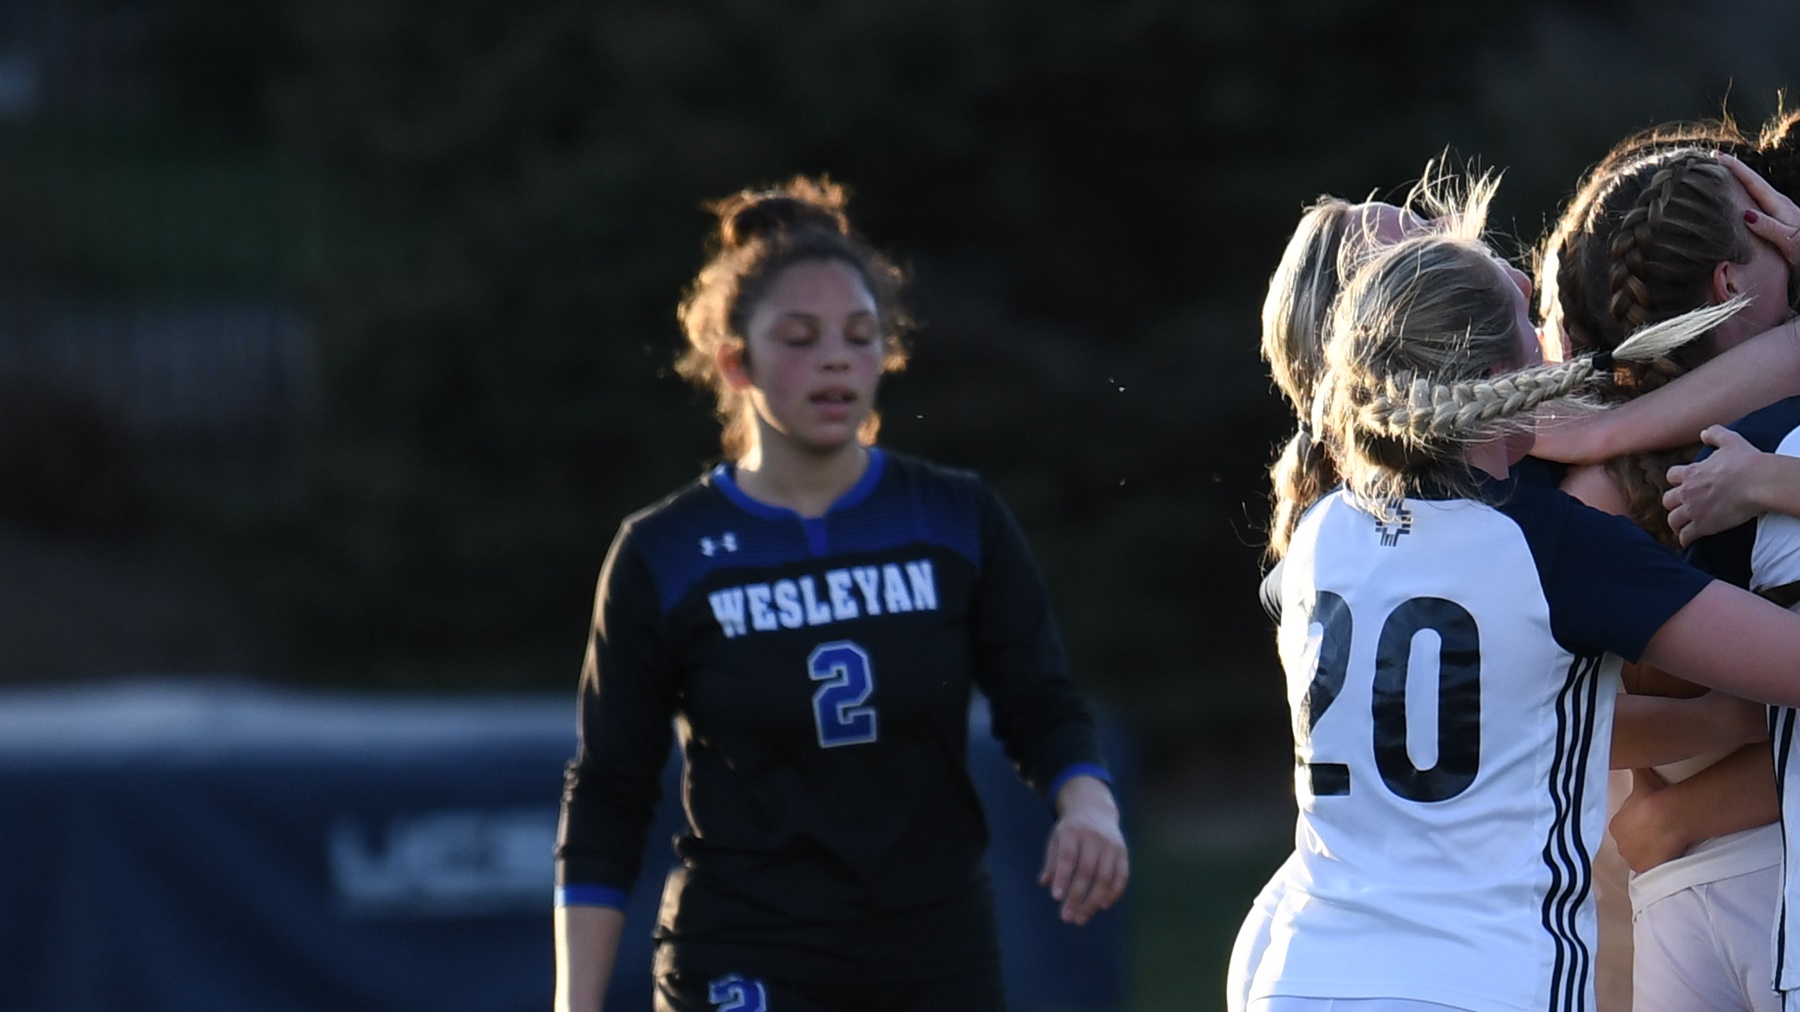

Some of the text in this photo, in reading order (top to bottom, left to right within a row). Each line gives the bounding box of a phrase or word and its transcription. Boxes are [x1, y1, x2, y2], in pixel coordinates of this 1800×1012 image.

[708, 559, 938, 639] WESLEYAN
[807, 639, 877, 748] 2
[1303, 589, 1481, 802] 20
